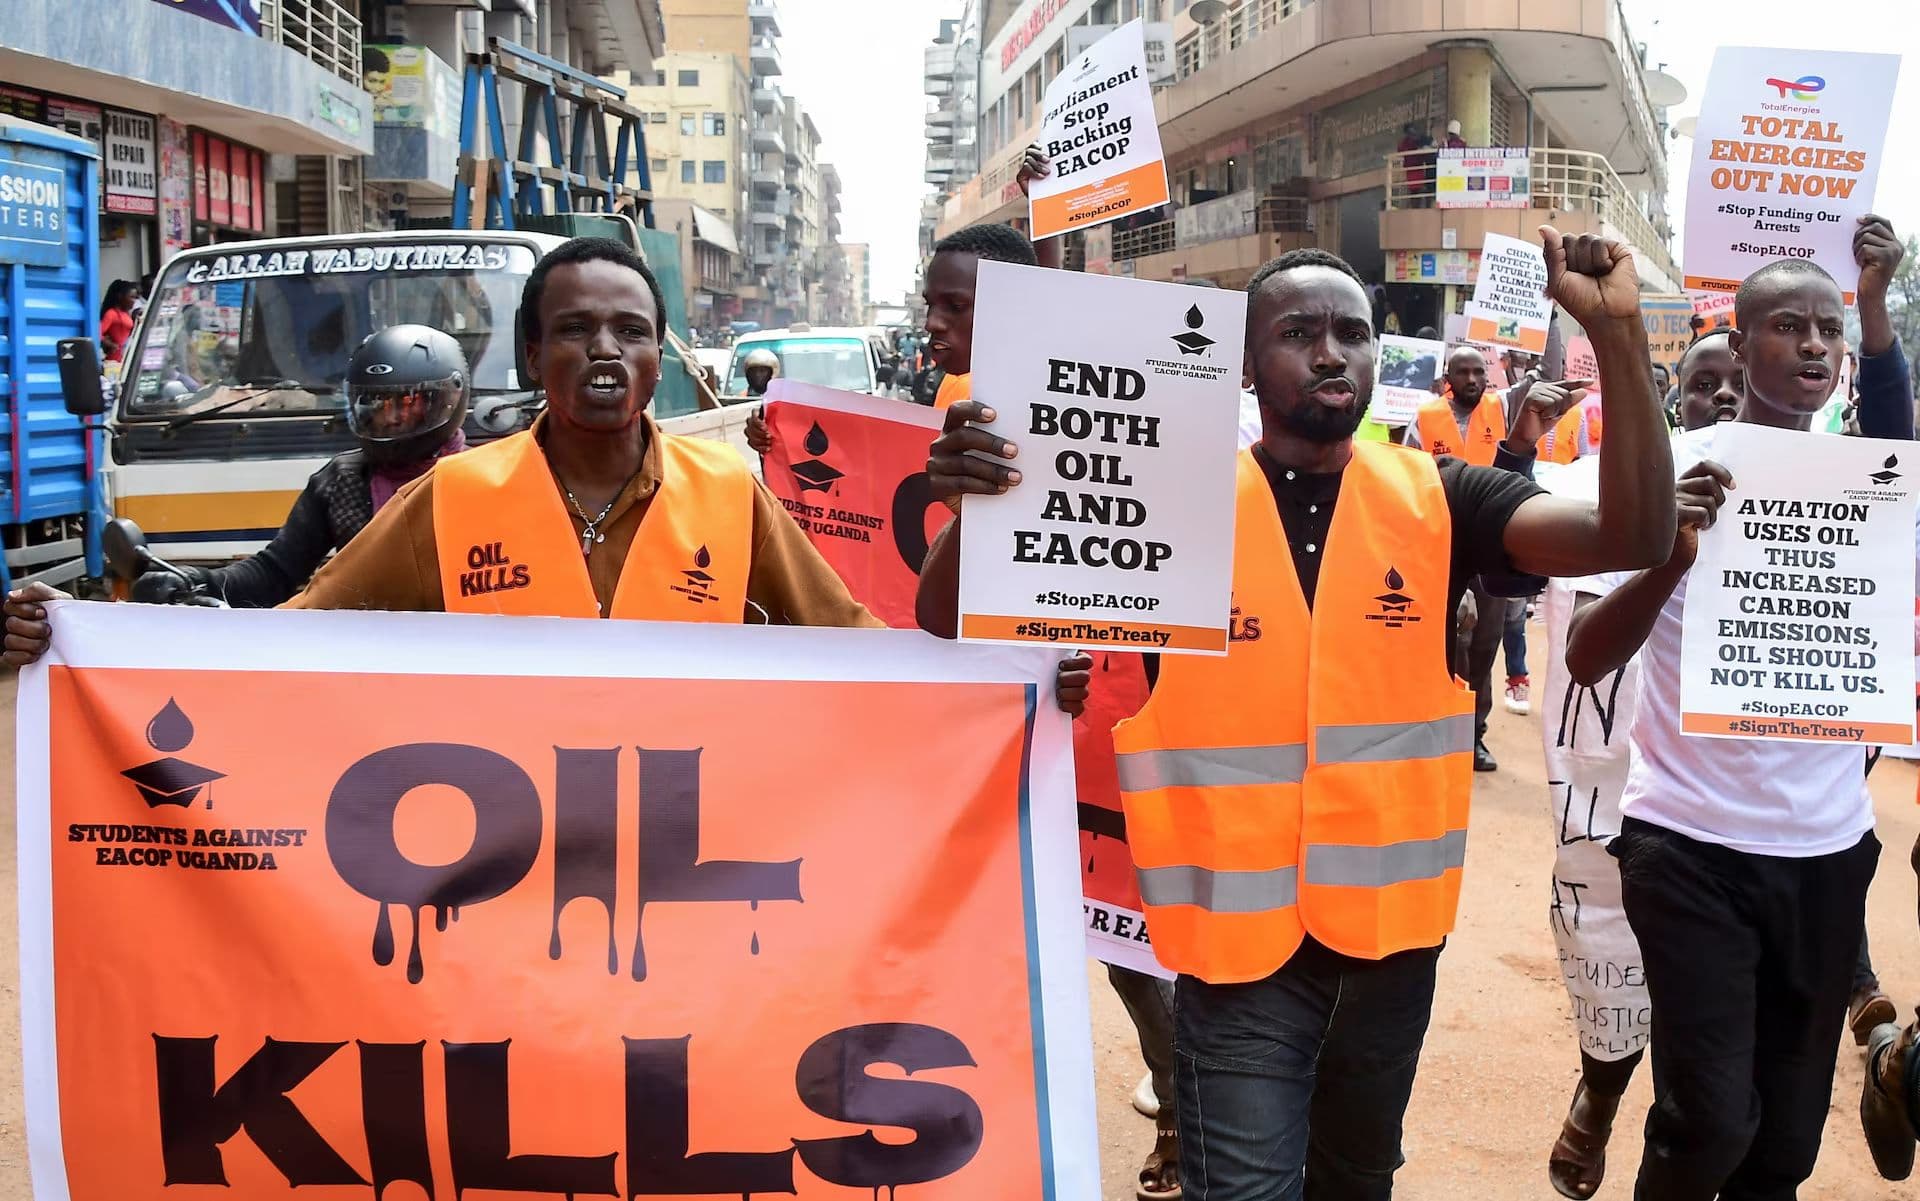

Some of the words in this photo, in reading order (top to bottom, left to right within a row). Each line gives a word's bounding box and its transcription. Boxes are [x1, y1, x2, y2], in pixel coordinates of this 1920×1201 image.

[1043, 65, 1139, 128] Parliament
[1760, 102, 1821, 114] TotalEnergies
[1064, 101, 1109, 131] Stop
[1047, 115, 1133, 159] Backing
[1741, 115, 1843, 143] TOTAL
[112, 143, 145, 164] REPAIR
[1055, 137, 1130, 178] EACOP
[1709, 140, 1866, 172] ENERGIES
[127, 171, 153, 190] SALES
[1711, 168, 1775, 193] OUT
[1779, 173, 1857, 199] NOW
[1068, 198, 1132, 222] #StopEACOP
[1717, 204, 1755, 218] #Stop
[1758, 207, 1812, 222] Funding
[1817, 211, 1841, 223] Our
[1753, 219, 1801, 233] Arrests
[1506, 248, 1536, 261] CHINA
[1730, 242, 1815, 259] #StopEACOP
[207, 251, 309, 281] ALLAH
[1486, 253, 1532, 269] PROTECT
[1534, 264, 1546, 273] OU
[1491, 263, 1533, 280] FUTURE,
[1489, 273, 1497, 281] A
[1489, 293, 1501, 301] IN
[1503, 296, 1538, 309] GREEN
[1496, 284, 1534, 299] LEADER
[1479, 300, 1546, 320] TRANSITION.
[1664, 341, 1674, 353] of
[1145, 359, 1189, 370] STUDENTS
[1190, 364, 1229, 375] AGAINST
[1155, 367, 1181, 376] EACOP
[1182, 371, 1218, 381] UGANDA
[1047, 359, 1146, 401] END
[1029, 403, 1161, 448] BOTH
[1055, 451, 1133, 486] OIL
[826, 508, 884, 530] AGAINST
[1040, 490, 1147, 527] AND
[1737, 499, 1870, 522] AVIATION
[813, 522, 871, 543] UGANDA
[1744, 523, 1810, 543] USES
[1817, 526, 1860, 547] OIL
[467, 542, 509, 570] OIL
[1013, 531, 1172, 572] EACOP
[1765, 548, 1836, 569] THUS
[459, 564, 531, 598] KILLS
[1722, 570, 1876, 596] INCREASED
[1035, 591, 1160, 611] #StopEACOP
[1739, 595, 1852, 619] CARBON
[1015, 622, 1172, 646] #SignTheTreaty
[1718, 619, 1879, 650] EMISSIONS,
[1719, 644, 1762, 664] OIL
[1769, 648, 1876, 670] SHOULD
[1710, 668, 1767, 689] NOT
[1774, 672, 1835, 691] KILL
[1842, 675, 1885, 694] US.
[1741, 701, 1849, 717] #StopEACOP
[1728, 720, 1864, 741] #SignTheTreaty
[68, 824, 188, 847] STUDENTS
[192, 829, 307, 847] AGAINST
[96, 848, 172, 867] EACOP
[177, 851, 278, 870] UGANDA
[325, 742, 804, 983] OIL
[151, 1022, 984, 1201] KILLS
